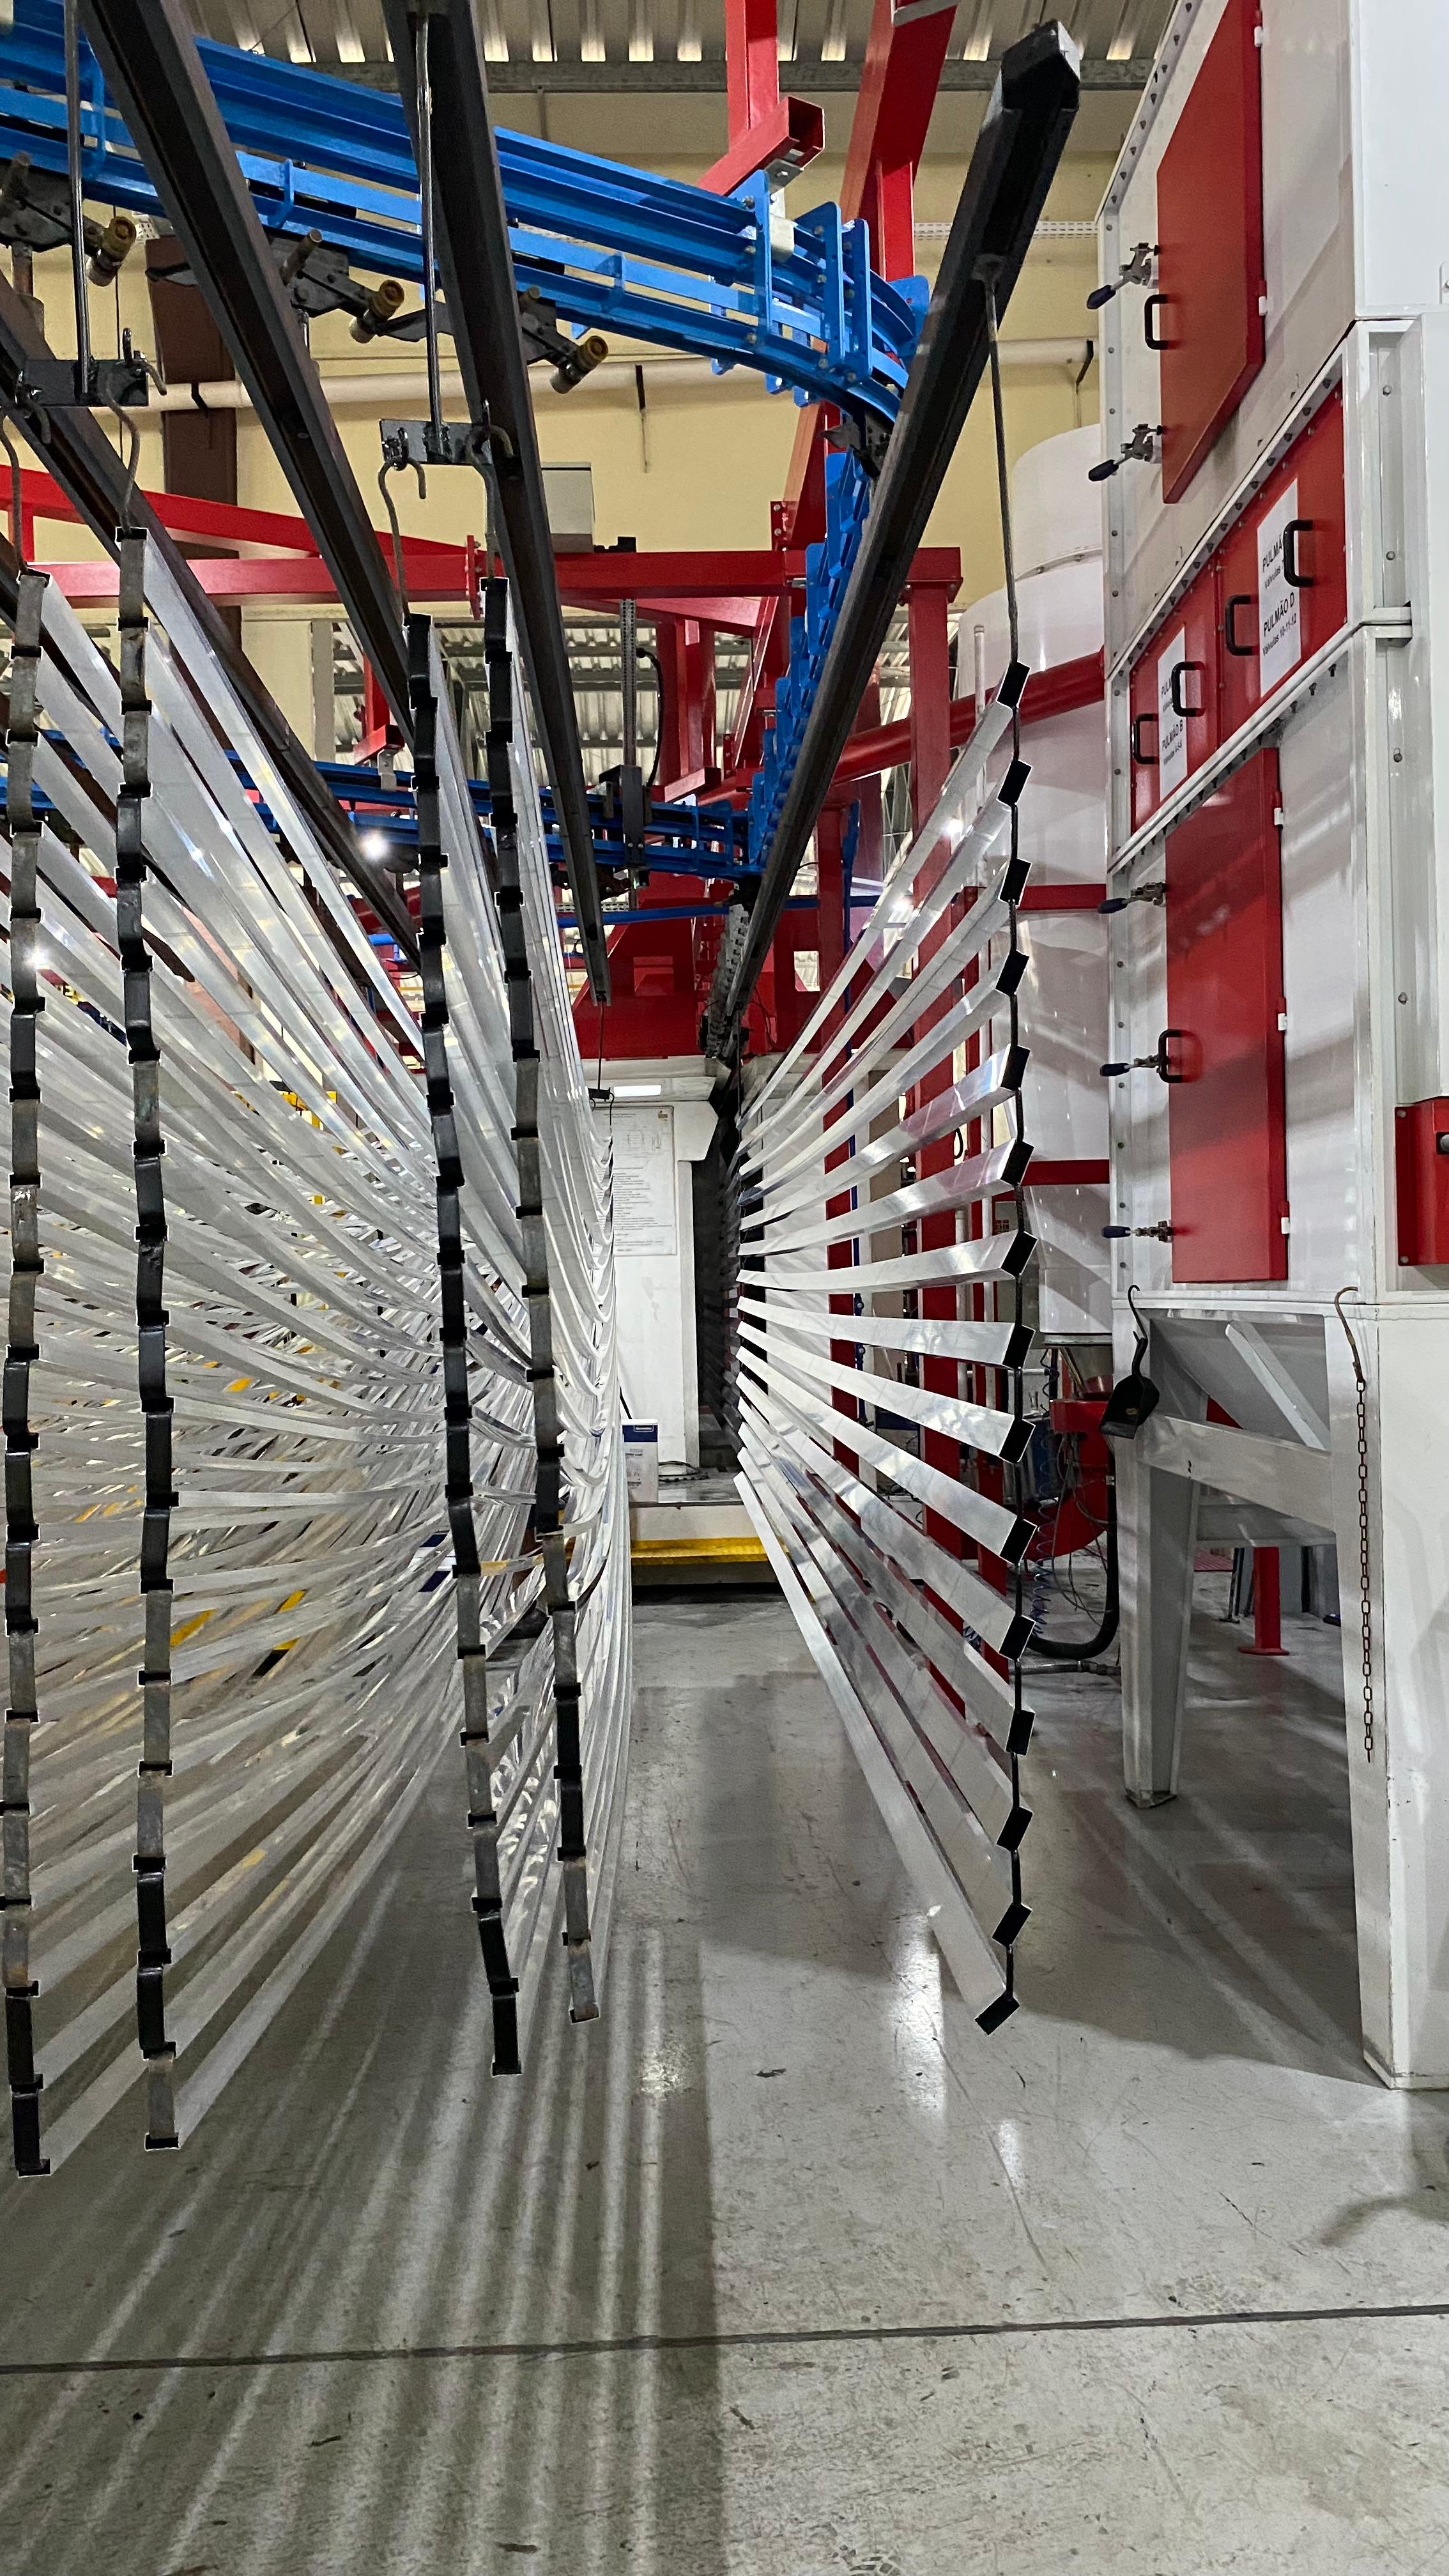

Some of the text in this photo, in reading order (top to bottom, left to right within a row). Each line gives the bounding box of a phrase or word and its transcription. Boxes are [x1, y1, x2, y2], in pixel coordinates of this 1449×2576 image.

[1262, 534, 1282, 573] PULMÃ
[1264, 592, 1295, 637] PULMÃO D
[1162, 724, 1179, 752] PULMÃO
[1179, 719, 1183, 732] B
